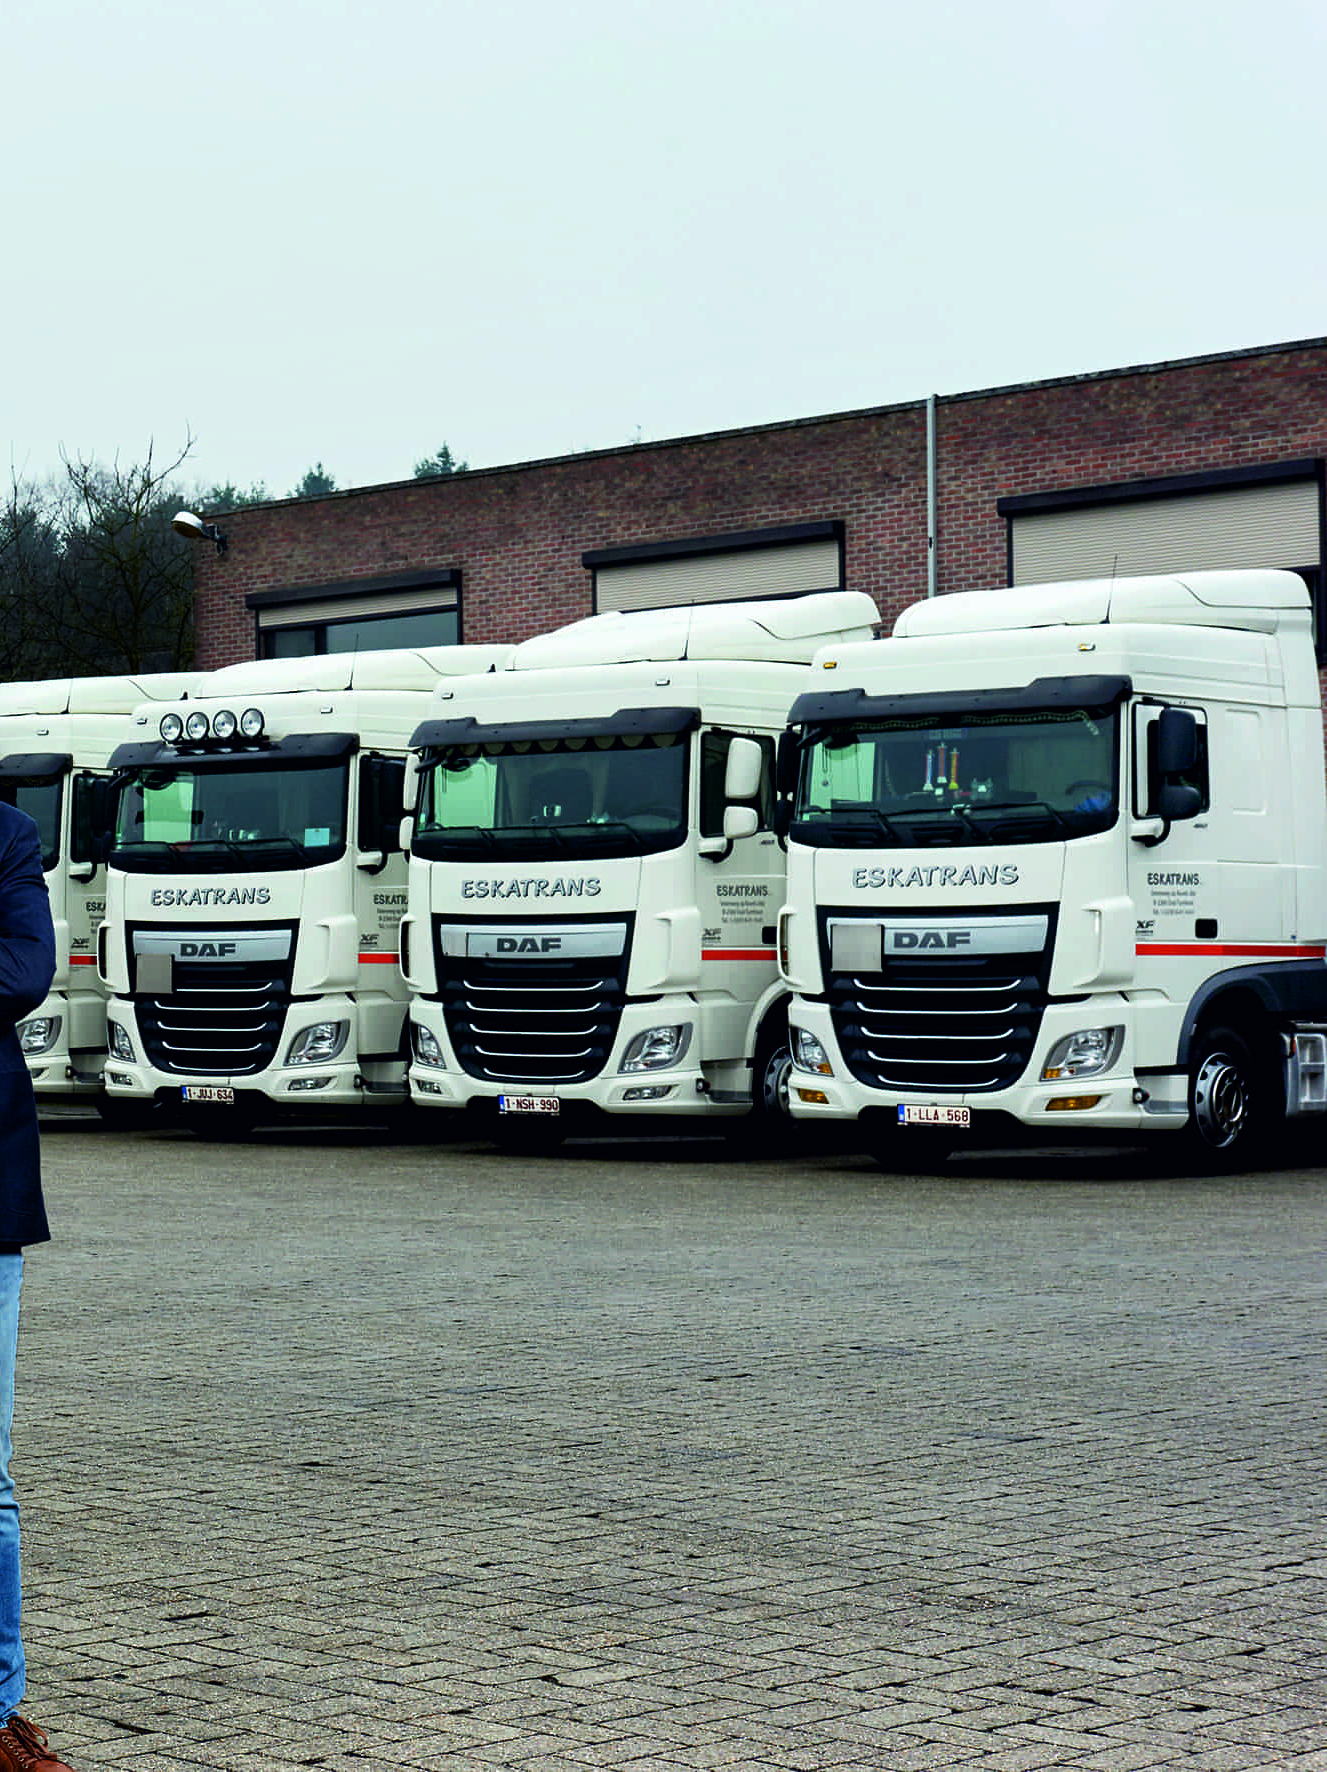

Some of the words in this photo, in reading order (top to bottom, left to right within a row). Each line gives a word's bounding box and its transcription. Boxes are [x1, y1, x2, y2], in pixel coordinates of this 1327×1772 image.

[852, 864, 1020, 888] ESKATRANS
[1147, 872, 1200, 886] ESKATRANS
[461, 878, 602, 898] ESKATRANS
[716, 884, 769, 897] ESKATRANS
[151, 887, 272, 906] ESKATRANS
[373, 894, 409, 905] ESKATR
[1136, 920, 1155, 929] XF
[496, 937, 561, 953] DAF
[893, 931, 971, 949] DAF
[180, 943, 236, 957] DAF
